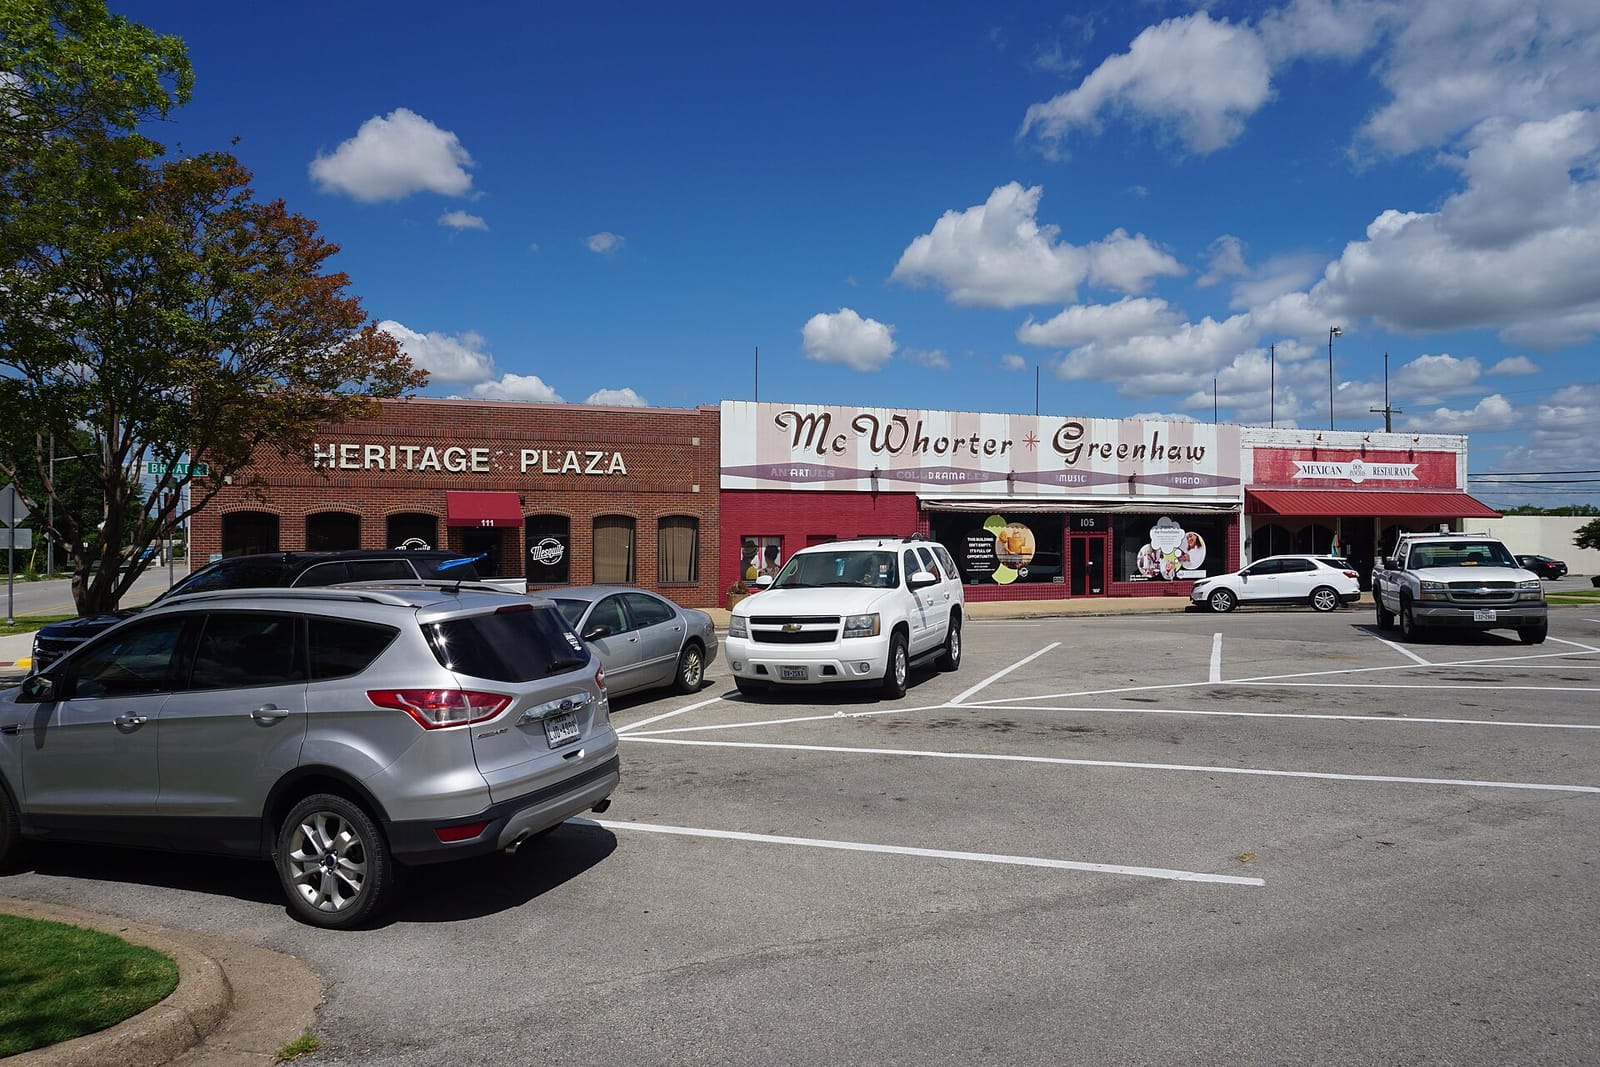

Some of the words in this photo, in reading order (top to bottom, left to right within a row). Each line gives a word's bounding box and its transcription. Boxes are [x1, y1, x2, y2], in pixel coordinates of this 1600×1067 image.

[1052, 421, 1206, 465] Greenhaw
[313, 443, 490, 473] HERITAGE
[520, 449, 627, 475] PLAZA
[790, 468, 809, 477] ART
[1302, 464, 1343, 475] MEXICAN
[1372, 466, 1411, 477] RESTAURANT
[928, 471, 966, 480] DRAMA
[1059, 474, 1088, 483] MUSIC
[1174, 476, 1200, 485] PIANO
[480, 519, 494, 527] 111
[1080, 518, 1095, 527] 105
